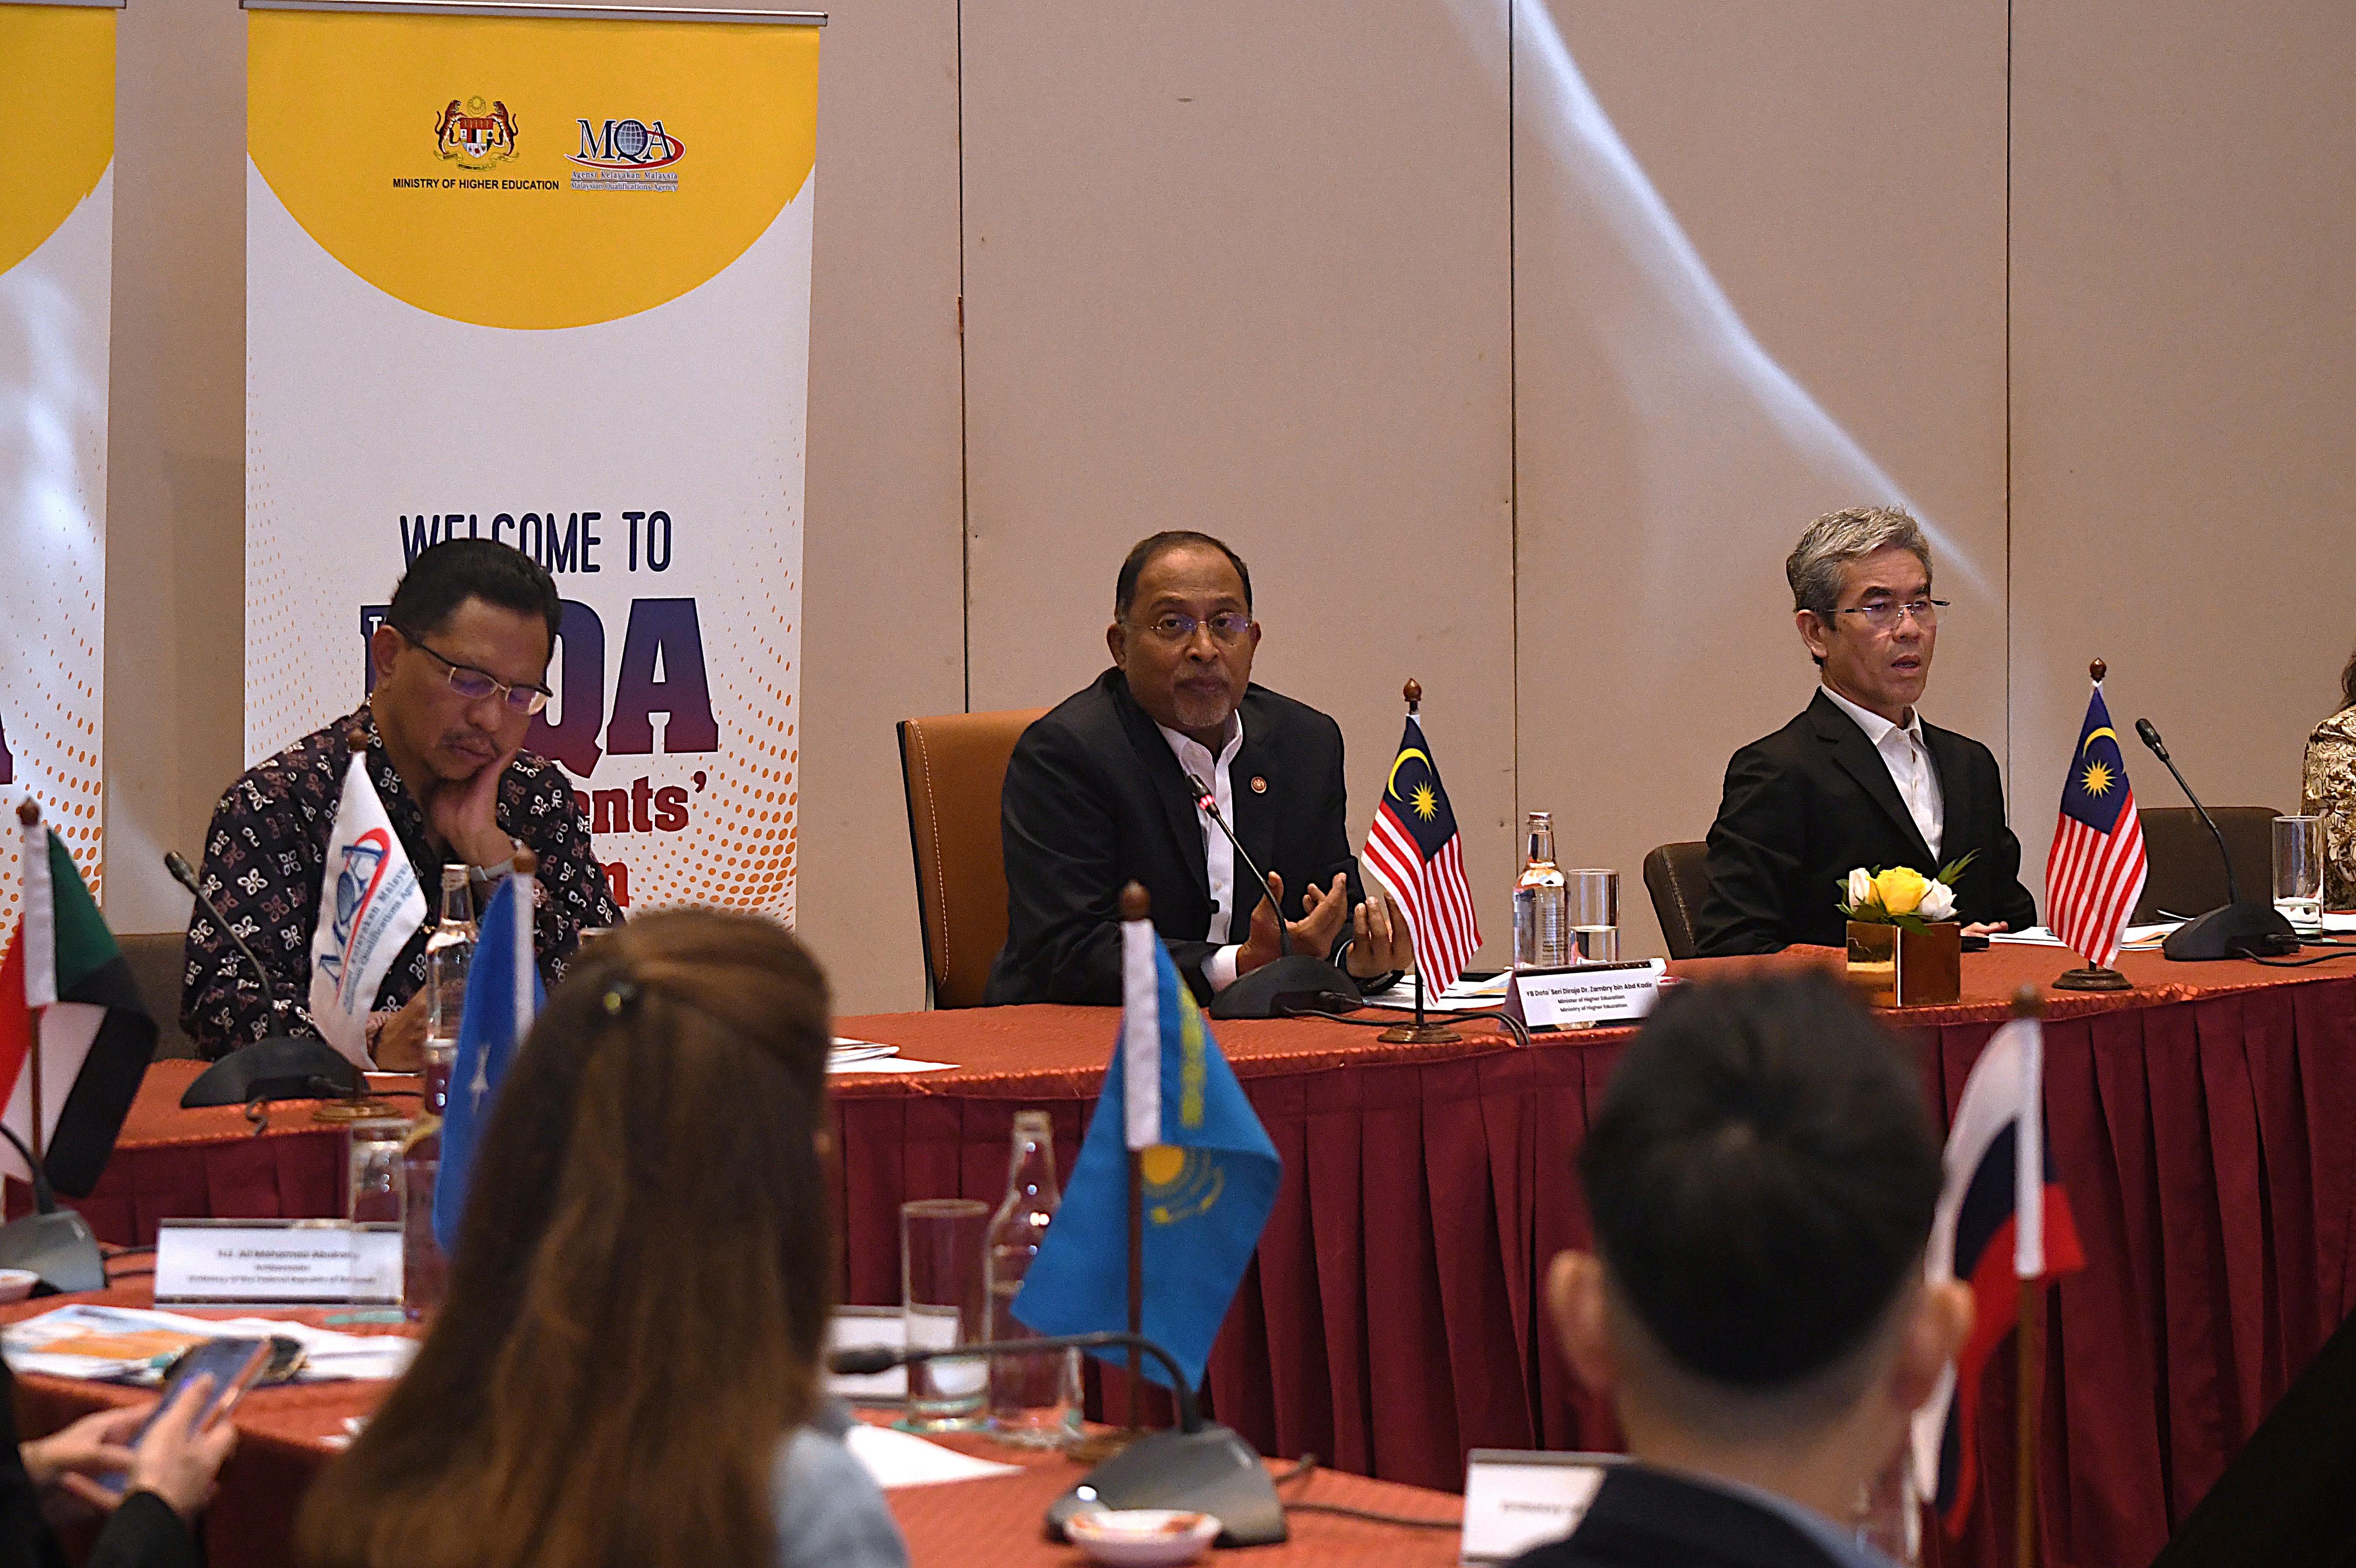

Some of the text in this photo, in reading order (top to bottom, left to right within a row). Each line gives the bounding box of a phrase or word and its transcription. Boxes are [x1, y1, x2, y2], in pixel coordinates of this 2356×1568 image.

[576, 119, 674, 163] MQA
[572, 171, 597, 179] Agensi
[393, 179, 559, 190] MINISTRY OF HIGHER EDUCATION
[654, 183, 677, 192] Agency
[622, 510, 671, 572] TO
